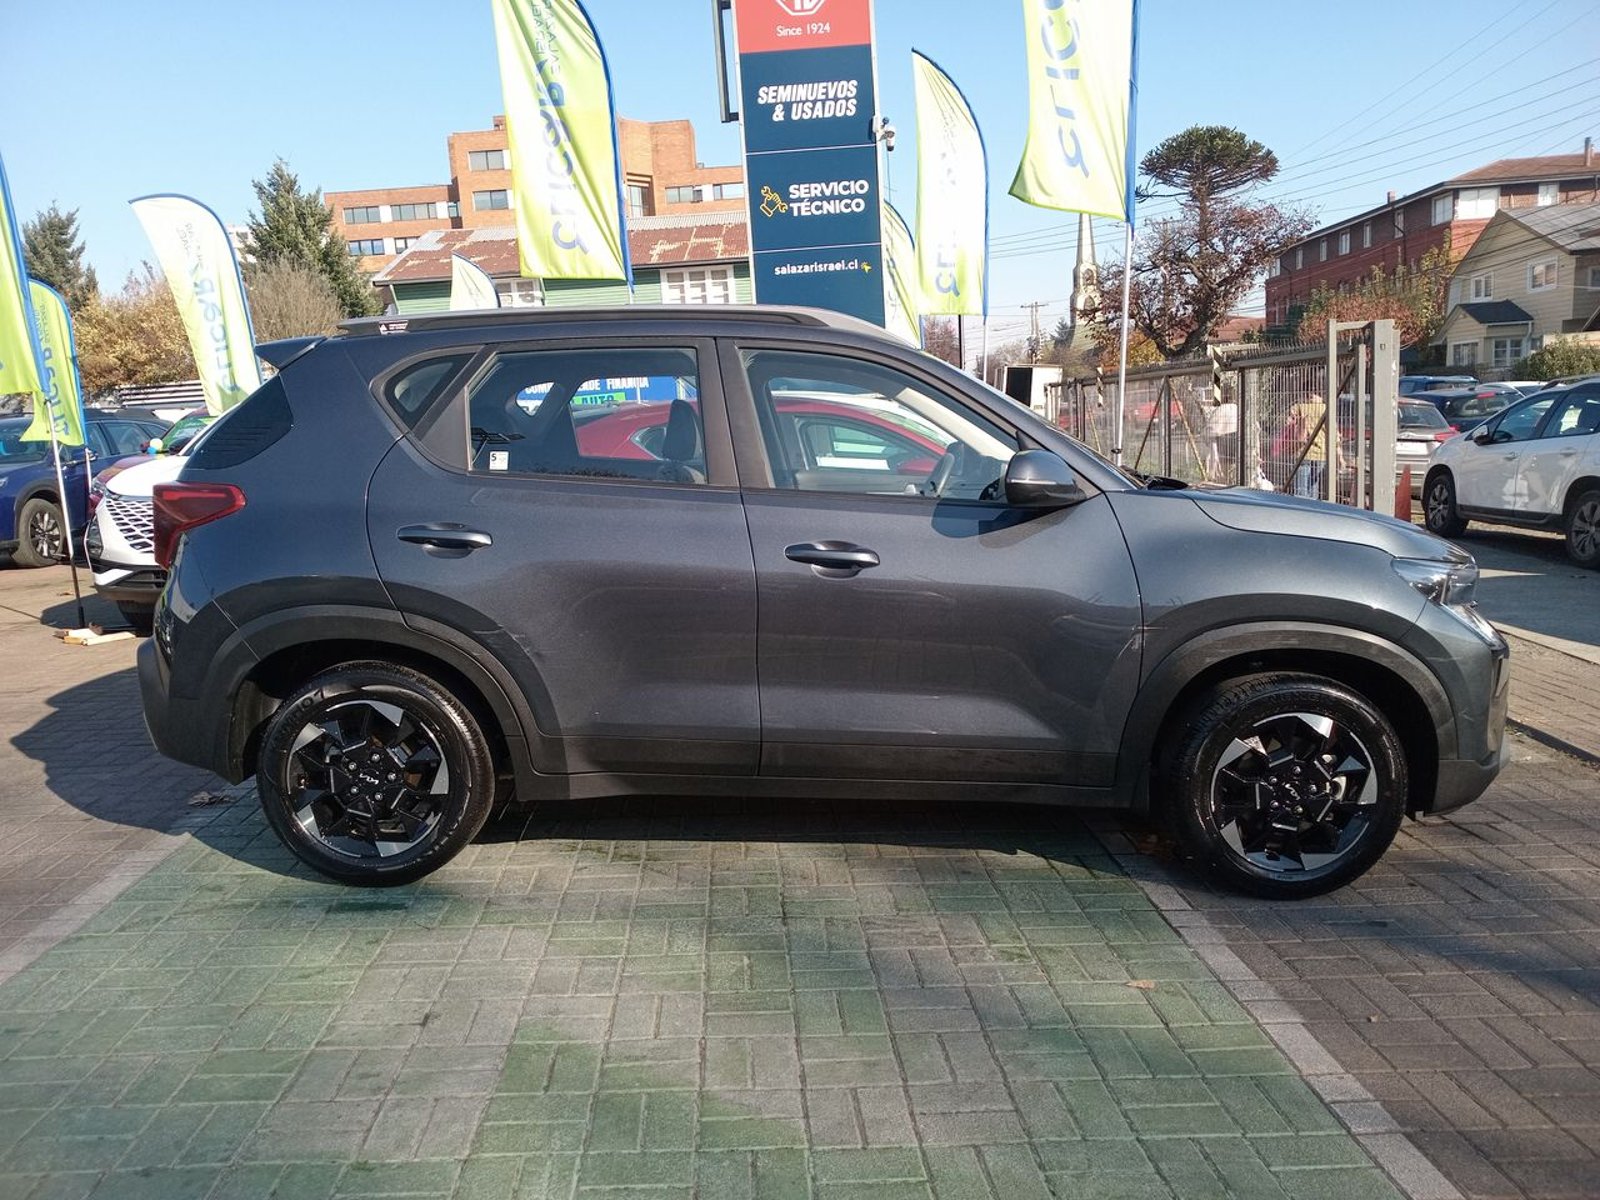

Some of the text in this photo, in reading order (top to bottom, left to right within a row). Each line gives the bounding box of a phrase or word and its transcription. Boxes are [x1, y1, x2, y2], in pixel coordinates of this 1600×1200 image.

[776, 22, 831, 37] Since 1924
[757, 79, 858, 104] SEMINUEVOS
[772, 98, 858, 122] & USADOS
[788, 179, 870, 199] SERVICIO
[789, 198, 866, 217] TÉCNICO
[774, 259, 858, 275] salazarisrael.cl
